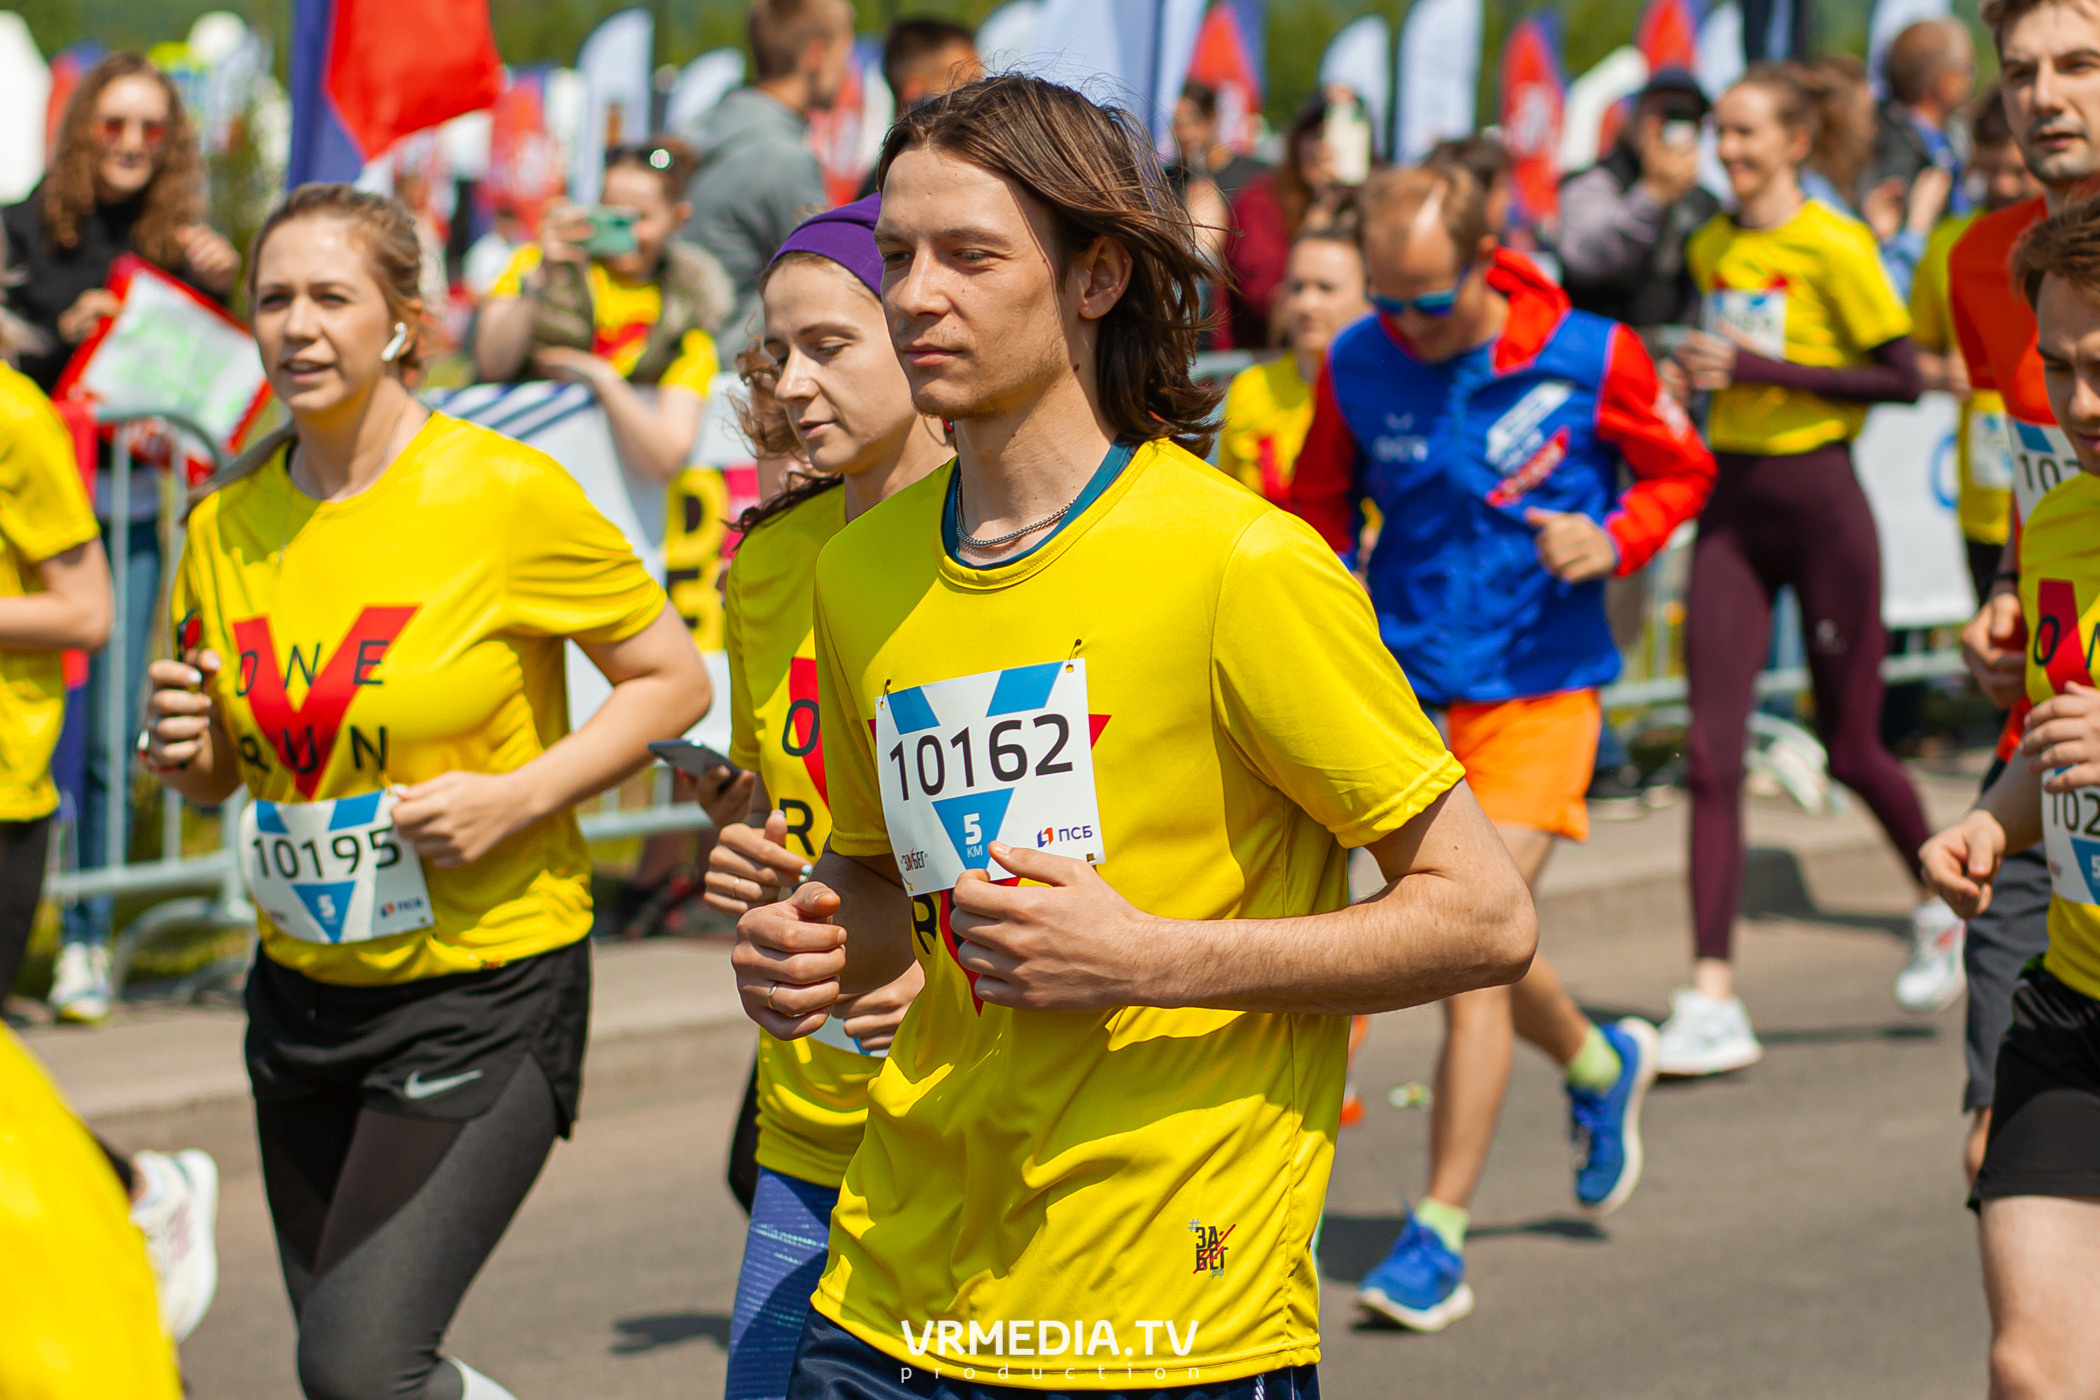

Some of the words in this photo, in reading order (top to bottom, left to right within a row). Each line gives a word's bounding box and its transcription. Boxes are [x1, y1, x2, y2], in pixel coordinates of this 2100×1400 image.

[235, 639, 389, 698] ONE
[239, 724, 388, 775] RUN
[888, 713, 1074, 802] 10162
[252, 825, 403, 880] 10195
[962, 812, 983, 846] 5
[1058, 825, 1094, 843] ПСБ
[317, 894, 336, 918] 5
